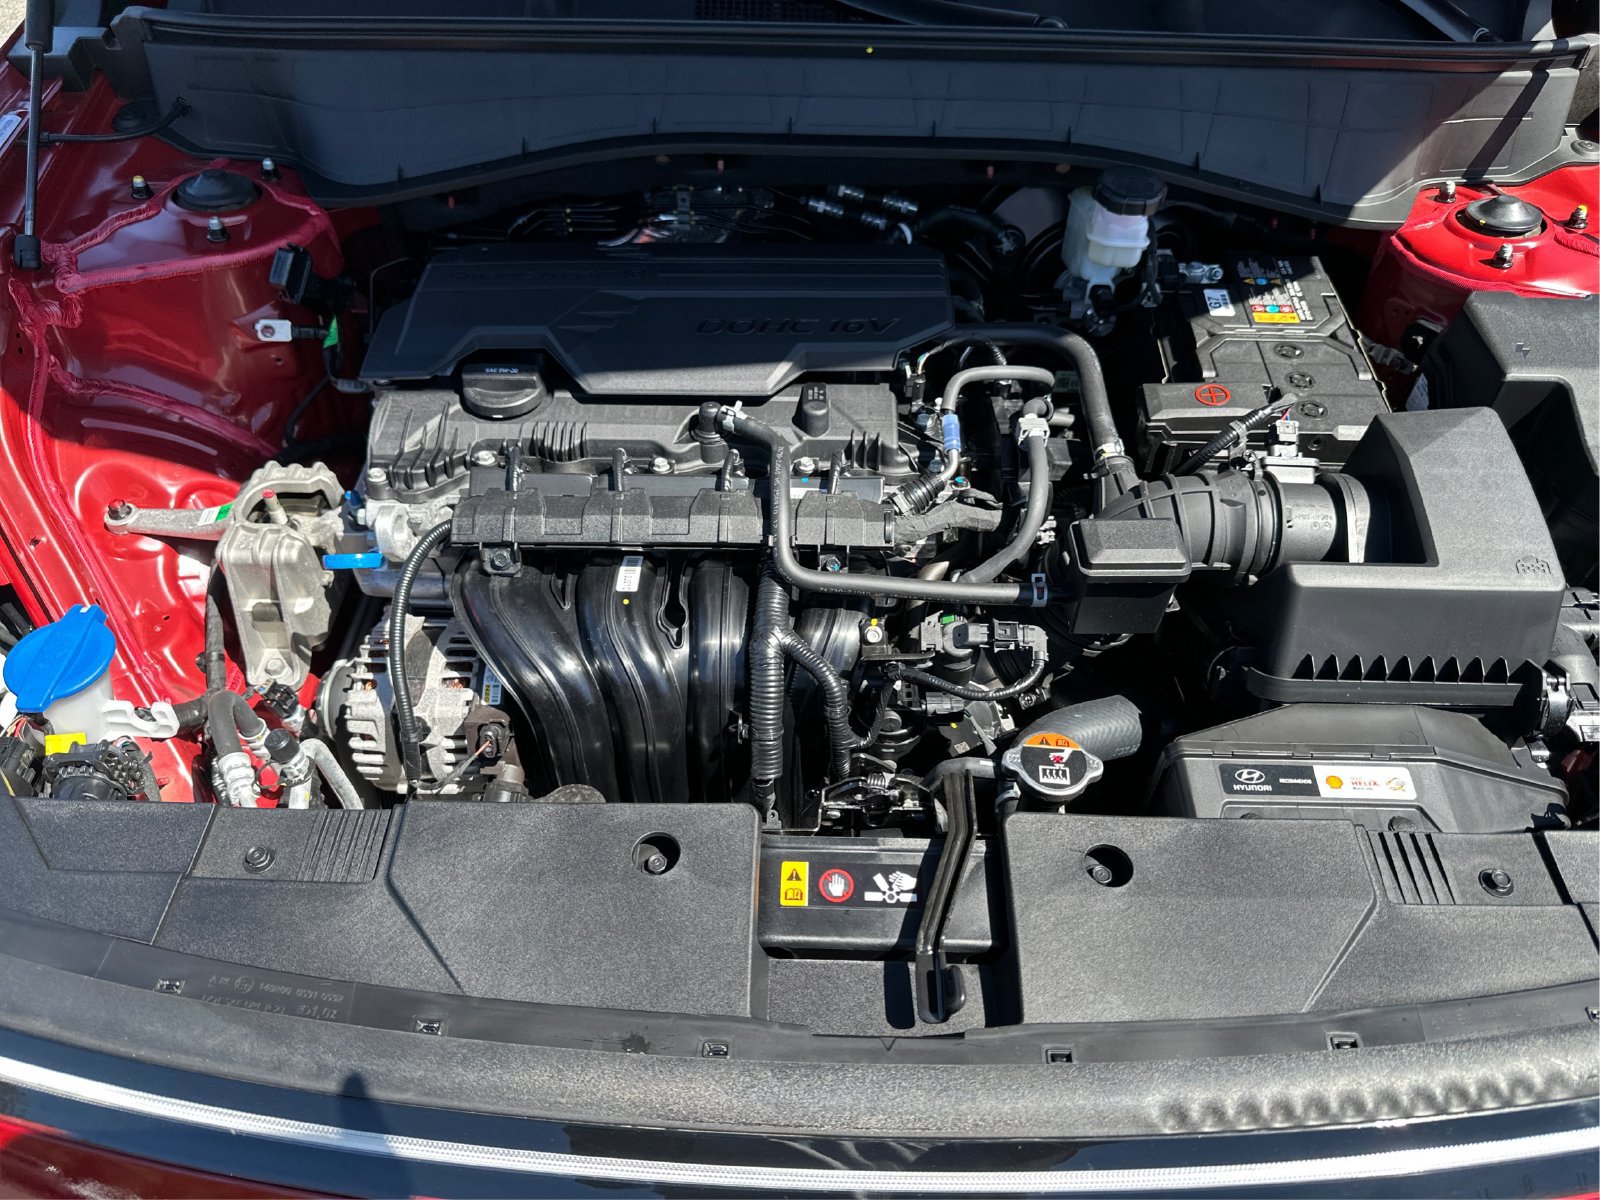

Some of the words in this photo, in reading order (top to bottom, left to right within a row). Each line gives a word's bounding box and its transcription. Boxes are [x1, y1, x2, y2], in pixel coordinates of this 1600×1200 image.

[1209, 296, 1221, 308] G7
[696, 318, 820, 336] DOHC
[828, 318, 901, 336] 16V
[1233, 784, 1272, 792] HYUNDAI
